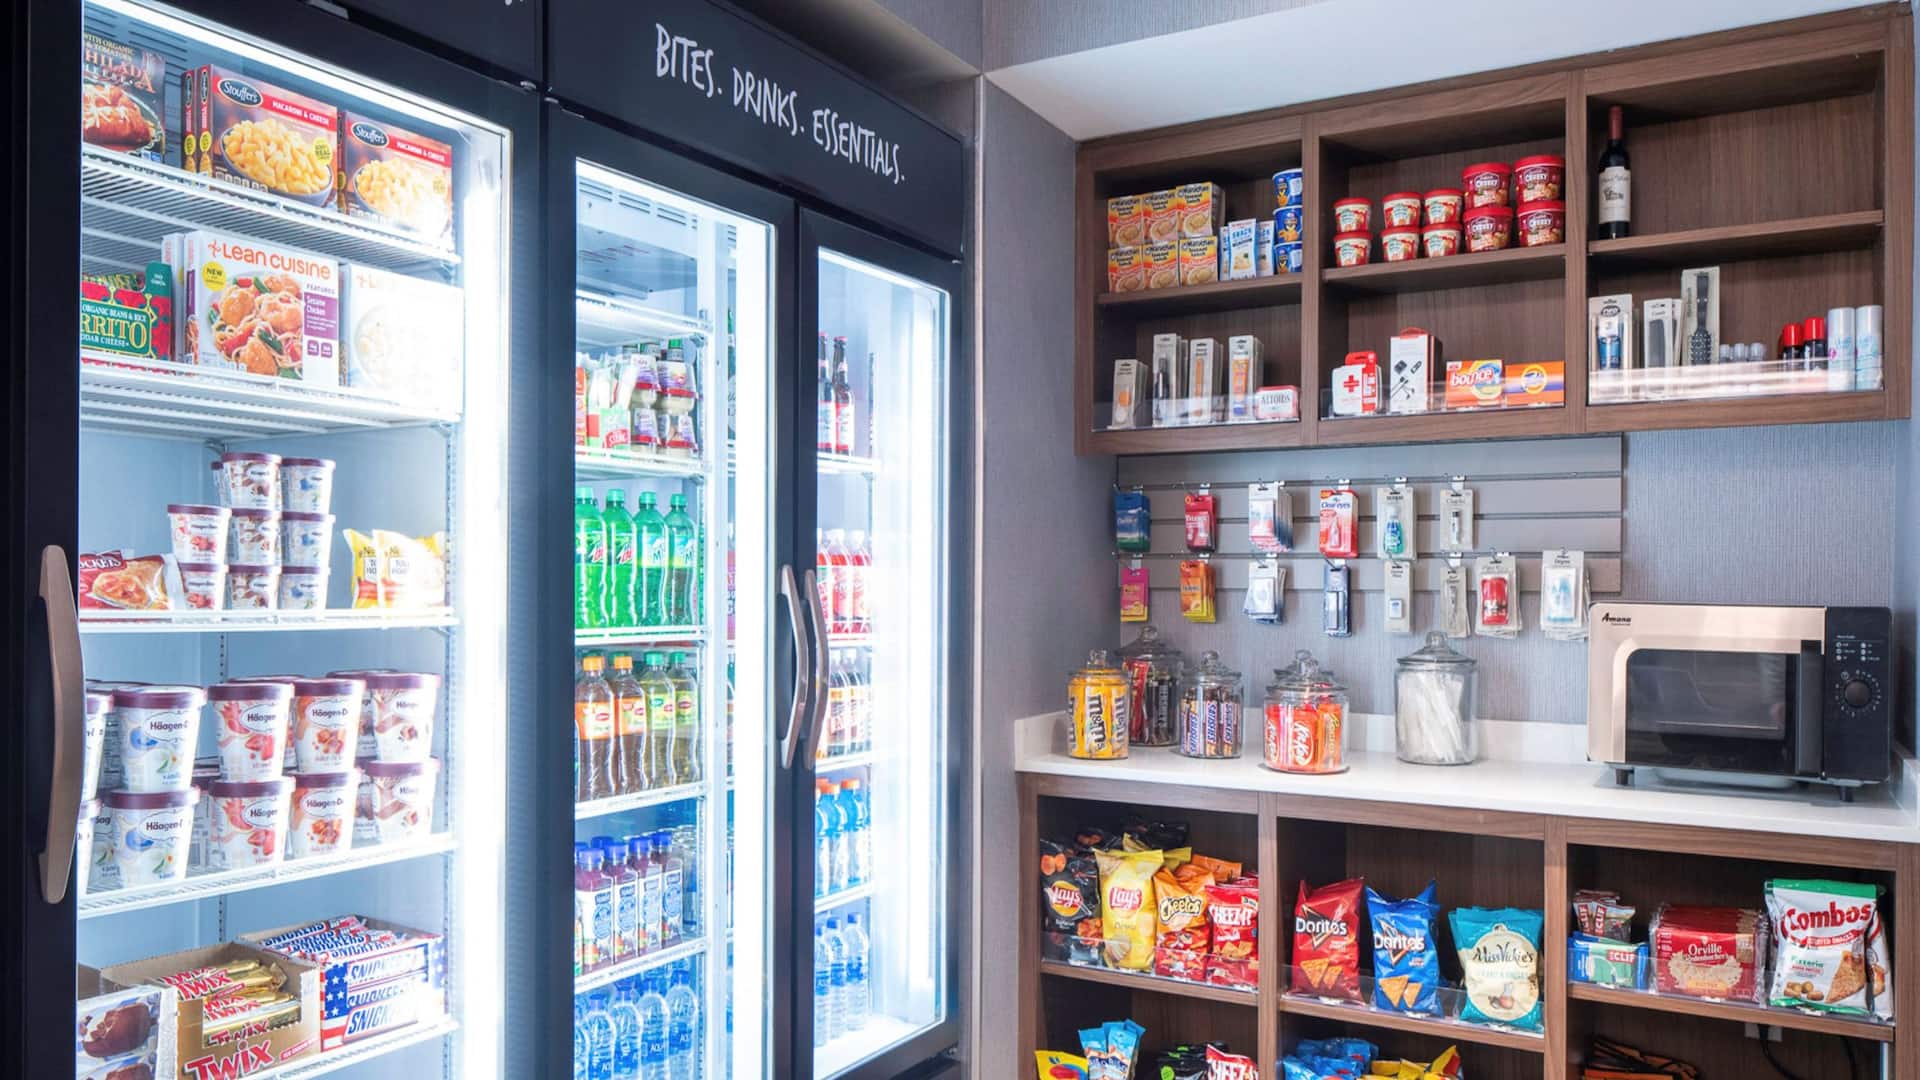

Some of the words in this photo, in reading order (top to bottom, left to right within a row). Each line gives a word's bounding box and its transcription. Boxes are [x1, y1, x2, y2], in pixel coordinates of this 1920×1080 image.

[223, 81, 259, 104] Stouffer's
[272, 101, 303, 116] MACARONI
[309, 112, 329, 125] CHEESE
[656, 23, 722, 98] BITES.
[732, 67, 804, 136] DRINKS.
[812, 108, 905, 185] ESSENTIALS.
[355, 125, 385, 144] Stouffer's
[223, 243, 266, 267] Lean
[207, 267, 222, 276] NEW
[1451, 368, 1494, 386] bounce
[1602, 612, 1632, 623] Amana
[1160, 896, 1202, 922] Cheetos
[1786, 901, 1872, 931] Combos
[265, 923, 324, 946] SNICKERS
[1296, 917, 1348, 935] Doritos
[1374, 932, 1425, 950] Doritos
[1688, 943, 1722, 956] Orville
[1615, 952, 1635, 963] CLIF
